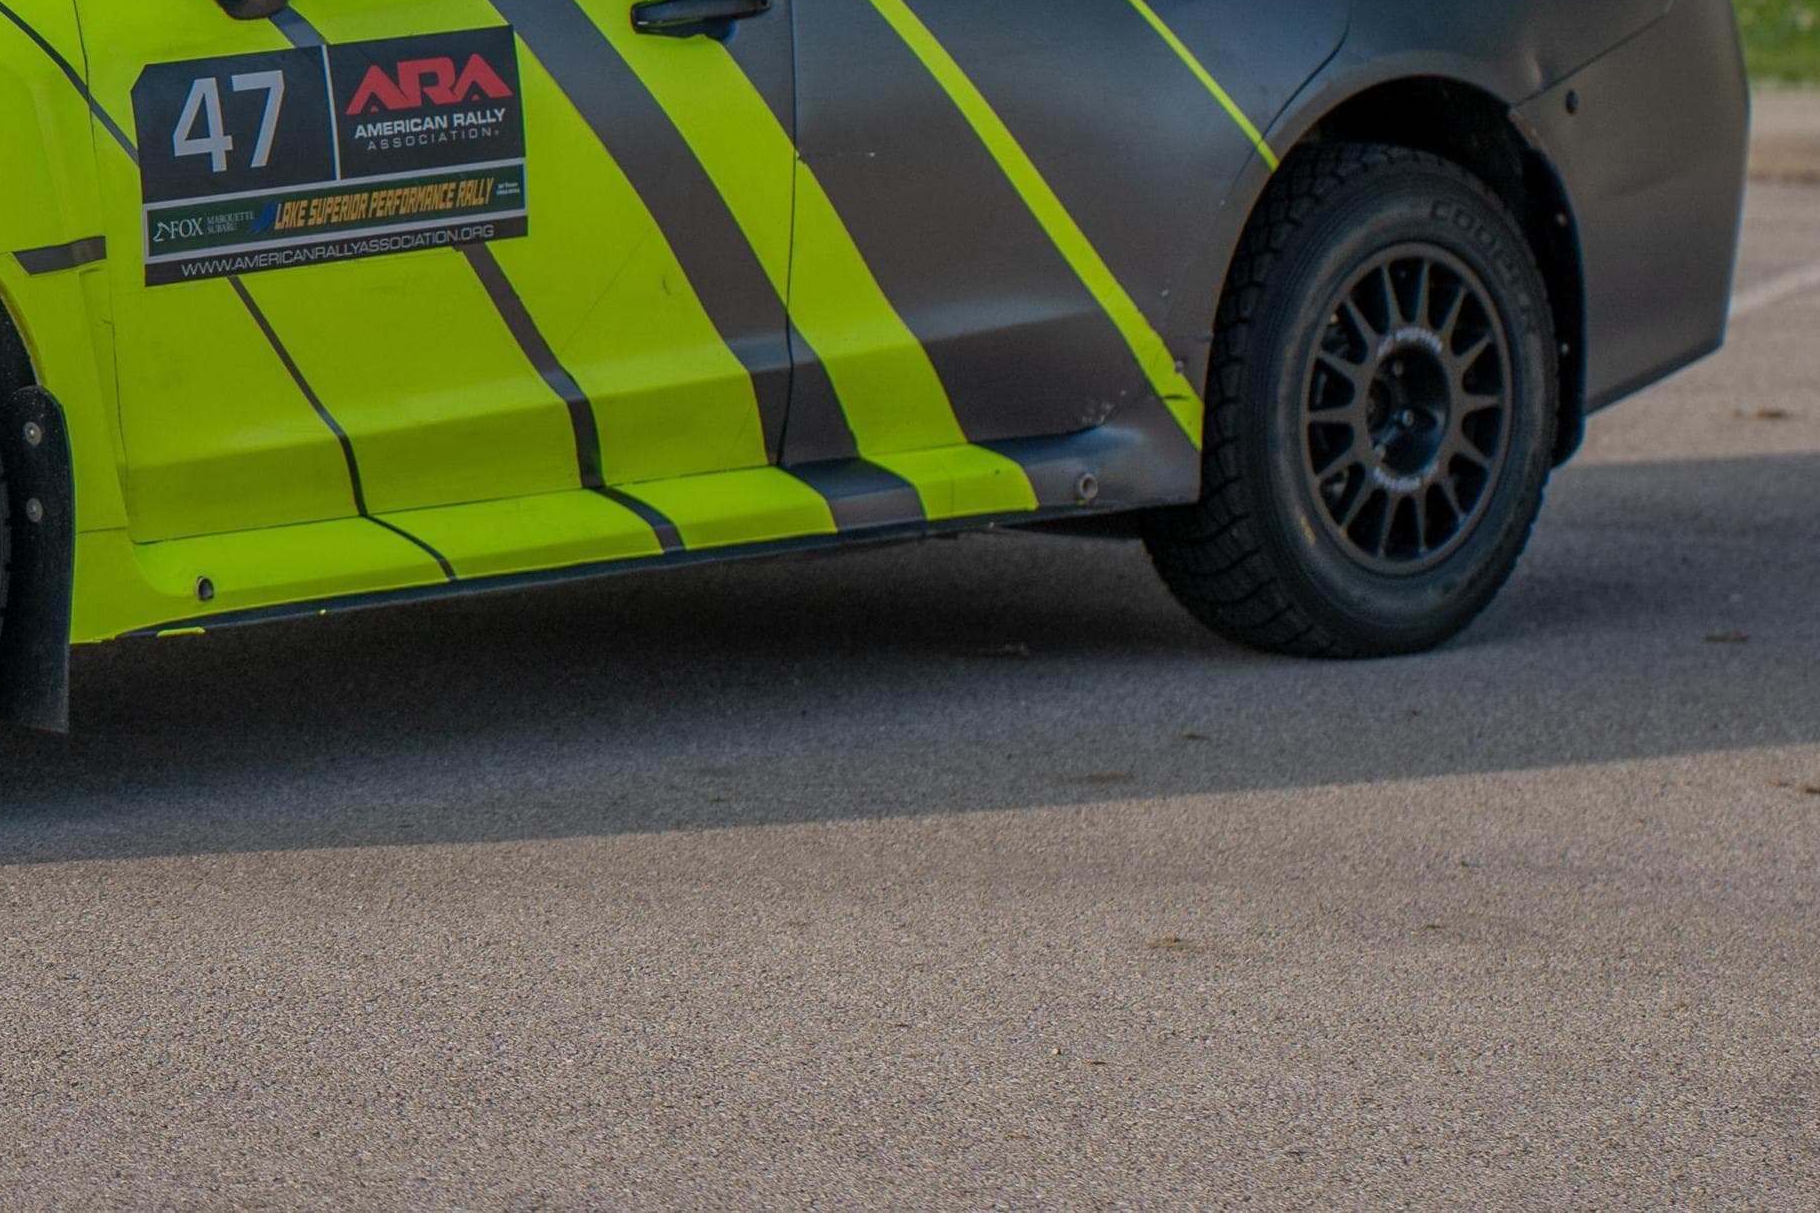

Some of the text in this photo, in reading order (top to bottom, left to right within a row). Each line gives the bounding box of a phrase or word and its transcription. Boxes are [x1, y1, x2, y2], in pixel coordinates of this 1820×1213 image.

[346, 53, 513, 115] ARA
[172, 69, 285, 173] 47
[354, 108, 506, 139] AMERICAN RALLY
[367, 127, 492, 151] ASSOCIATION
[170, 217, 204, 240] FOX
[274, 199, 309, 230] LAKE
[308, 192, 367, 226] SUPERIOR
[368, 181, 456, 220] PERFORMANCE
[455, 177, 495, 207] RALLY
[181, 224, 495, 277] WWW.AMERICANRALLYASSOCIATION.ORG
